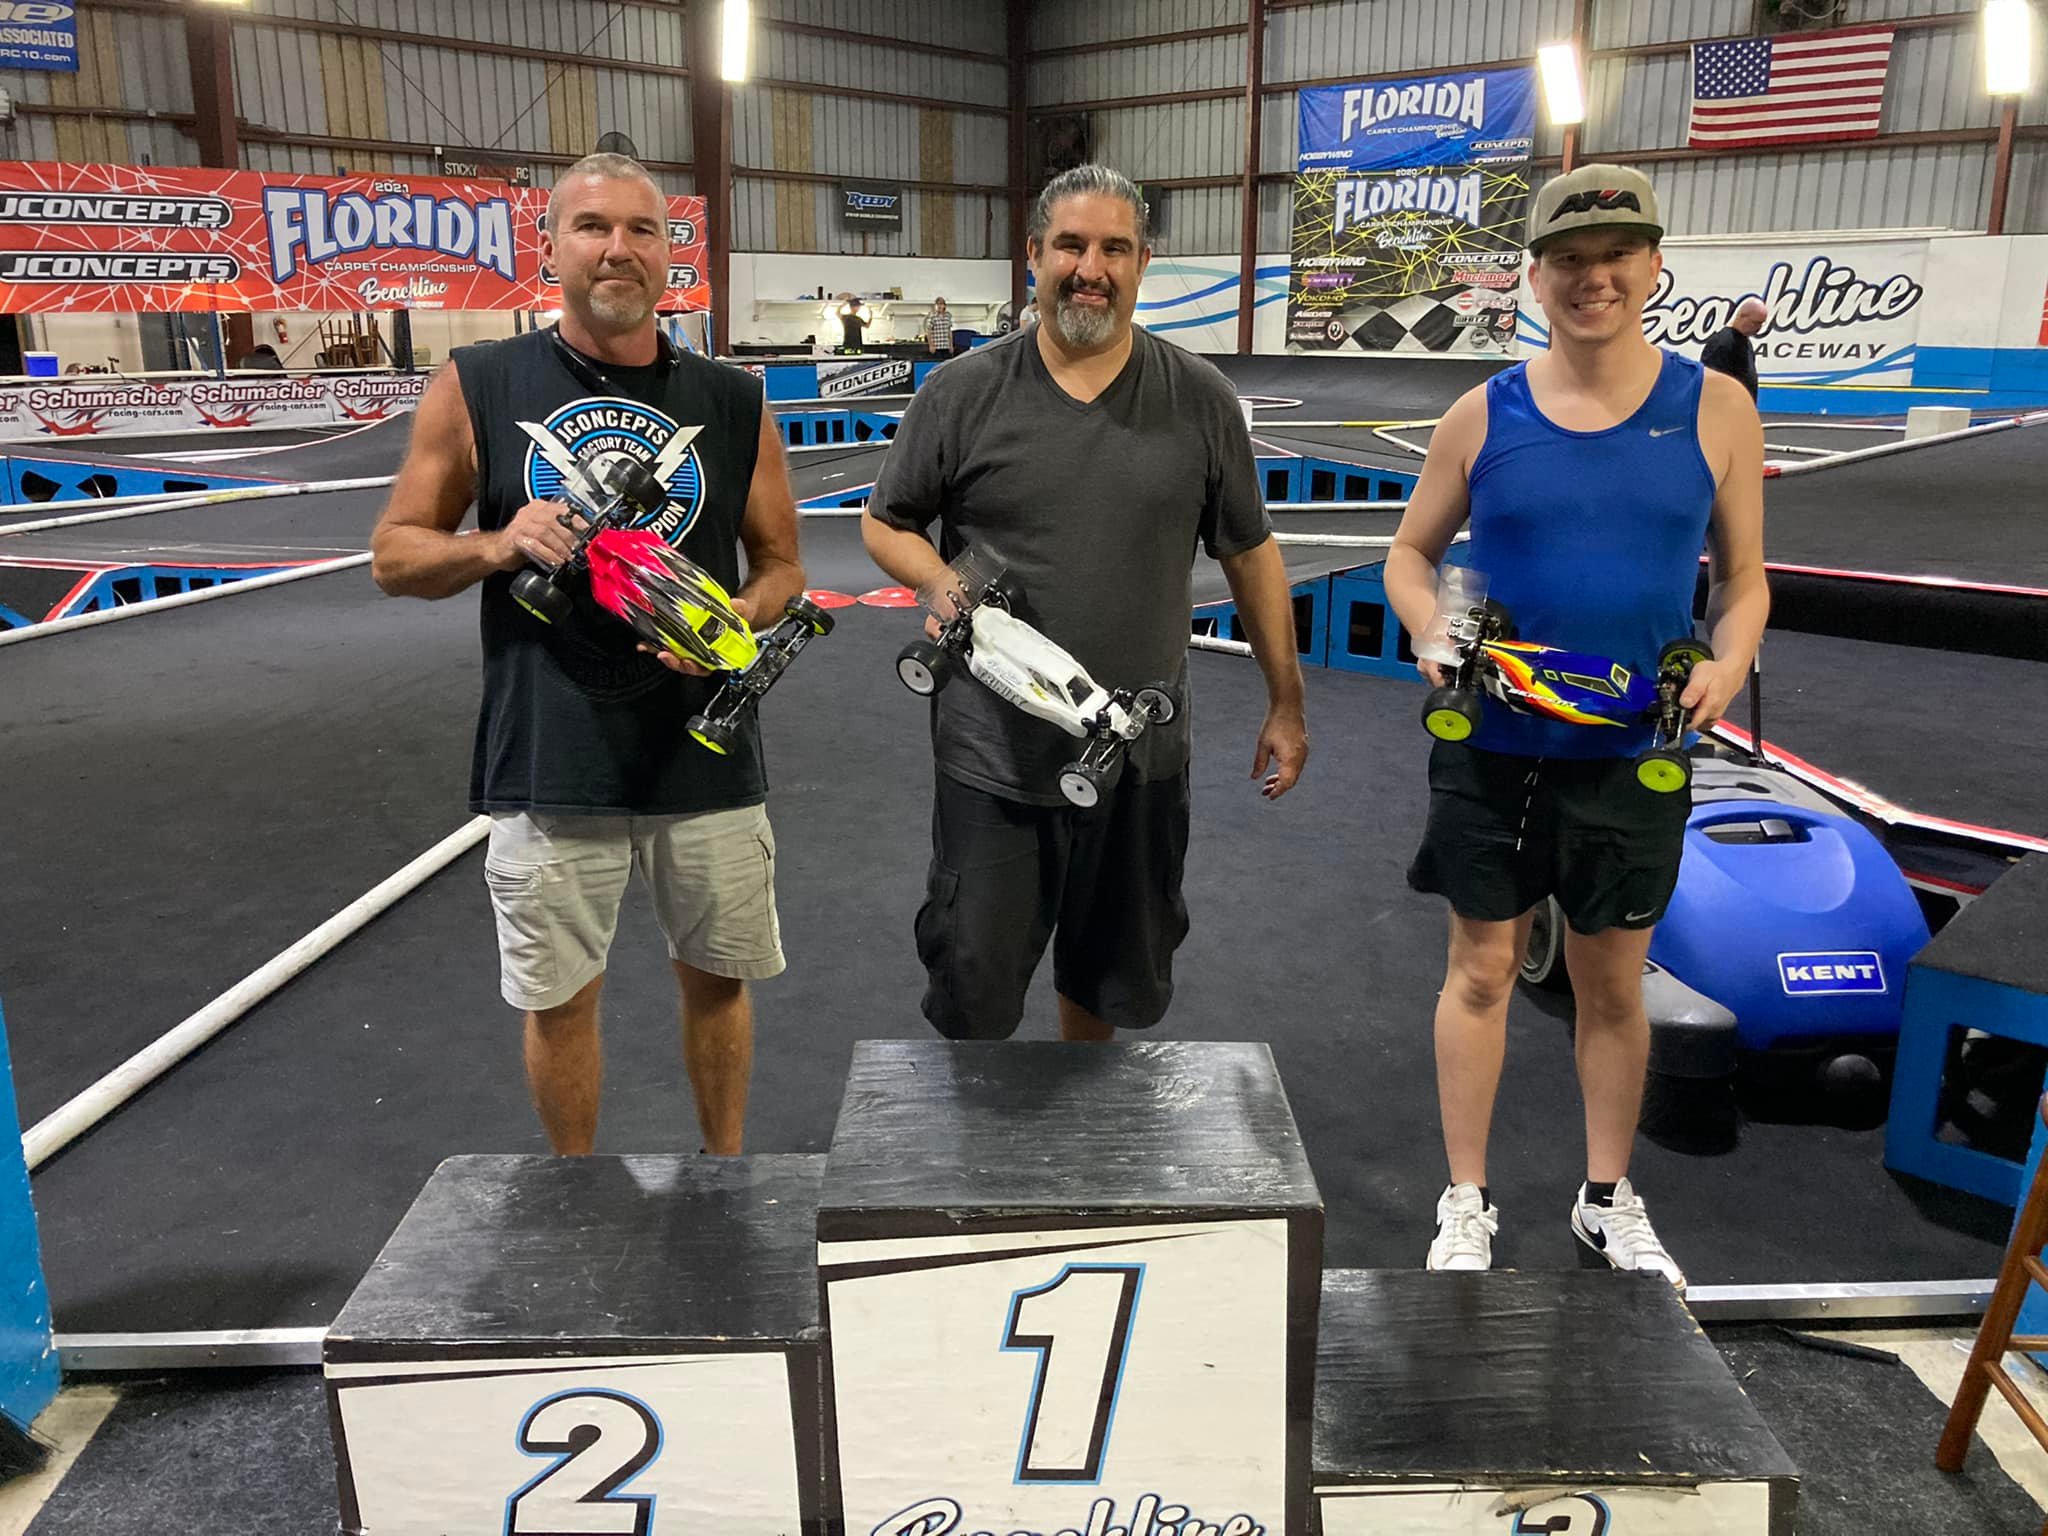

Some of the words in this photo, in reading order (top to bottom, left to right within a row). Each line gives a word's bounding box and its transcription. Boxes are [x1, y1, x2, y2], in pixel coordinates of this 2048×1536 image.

[1342, 78, 1486, 143] FLORIDA
[444, 162, 478, 177] STICKY
[516, 167, 529, 180] RC
[375, 181, 409, 193] 2021
[0, 198, 222, 221] JCONCEPTS
[1334, 174, 1481, 236] FLORIDA
[264, 187, 516, 283] FLORIDA
[2, 257, 230, 277] JCONCEPTS
[324, 262, 378, 272] CARPET
[380, 262, 477, 273] CHAMPIONSHIP
[358, 276, 449, 305] Beachline
[1754, 342, 1887, 359] ACEWAY
[334, 378, 429, 398] Schumac
[825, 361, 907, 395] JCONCEPTS
[30, 386, 183, 410] Schumacher
[192, 382, 327, 403] Schumacher
[109, 408, 183, 418] racing-cars.com
[261, 402, 327, 411] racing-cars.com
[556, 409, 669, 444] JCONCEPTS
[577, 436, 622, 461] FACTORY
[624, 437, 652, 463] TEAM
[1786, 964, 1875, 981] KENT
[1000, 1262, 1146, 1485] 1
[503, 1387, 664, 1536] 2
